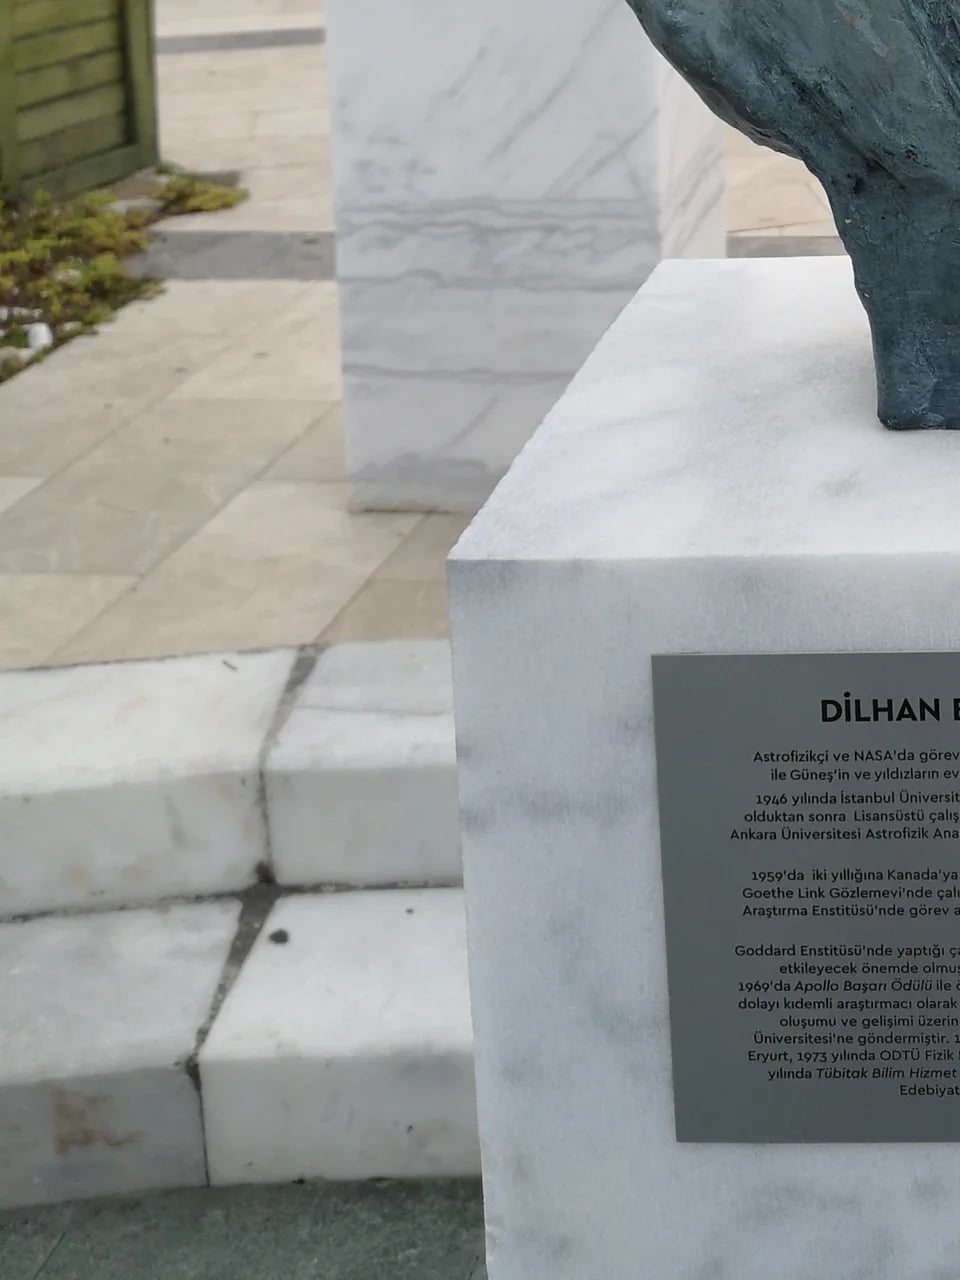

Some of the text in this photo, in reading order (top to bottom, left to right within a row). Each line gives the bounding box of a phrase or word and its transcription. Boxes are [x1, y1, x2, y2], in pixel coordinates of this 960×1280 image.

[820, 691, 940, 722] DİLHAN
[753, 749, 829, 765] Astrofizikçi
[832, 752, 850, 761] ve
[854, 748, 915, 761] NASA'da
[918, 748, 960, 764] görev
[770, 767, 787, 780] ile
[789, 767, 850, 783] Güneş'in
[854, 770, 871, 779] ve
[874, 766, 939, 782] yıldızların
[756, 791, 788, 806] 1946
[791, 791, 837, 807] yılında
[840, 789, 895, 803] İstanbul
[744, 809, 804, 822] olduktan
[808, 813, 846, 822] sonra
[853, 809, 924, 821] Lisansüstü
[751, 868, 804, 883] 1959'da
[812, 868, 827, 880] iki
[830, 868, 884, 883] yıllığına
[887, 867, 958, 883] Kanada'ya
[742, 904, 808, 919] Araştırma
[812, 903, 905, 916] Enstitüsü'nde
[908, 903, 950, 919] görev
[734, 944, 796, 956] Goddard
[800, 943, 893, 956] Enstitüsü'nde
[896, 943, 944, 959] yaptığı
[779, 961, 858, 977] etkileyecek
[861, 961, 920, 973] önemde
[738, 979, 791, 994] 1969'da
[793, 979, 839, 994] Apollo
[842, 979, 887, 994] Başarı
[890, 976, 932, 991] Ödülü
[933, 978, 952, 991] ile
[753, 1029, 856, 1044] Üniversitesi'ne
[857, 1031, 950, 1047] göndermiştir.
[748, 1049, 793, 1064] Eryurt,
[796, 1052, 828, 1063] 1973
[828, 1048, 876, 1064] yılında
[877, 1046, 920, 1061] ODTÜ
[922, 1048, 954, 1061] Fizik
[767, 1066, 812, 1081] yılında
[815, 1066, 868, 1078] Tübitak
[871, 1066, 905, 1078] Bilim
[909, 1065, 959, 1078] Hizmet
[899, 1083, 960, 1099] Edebiyat
